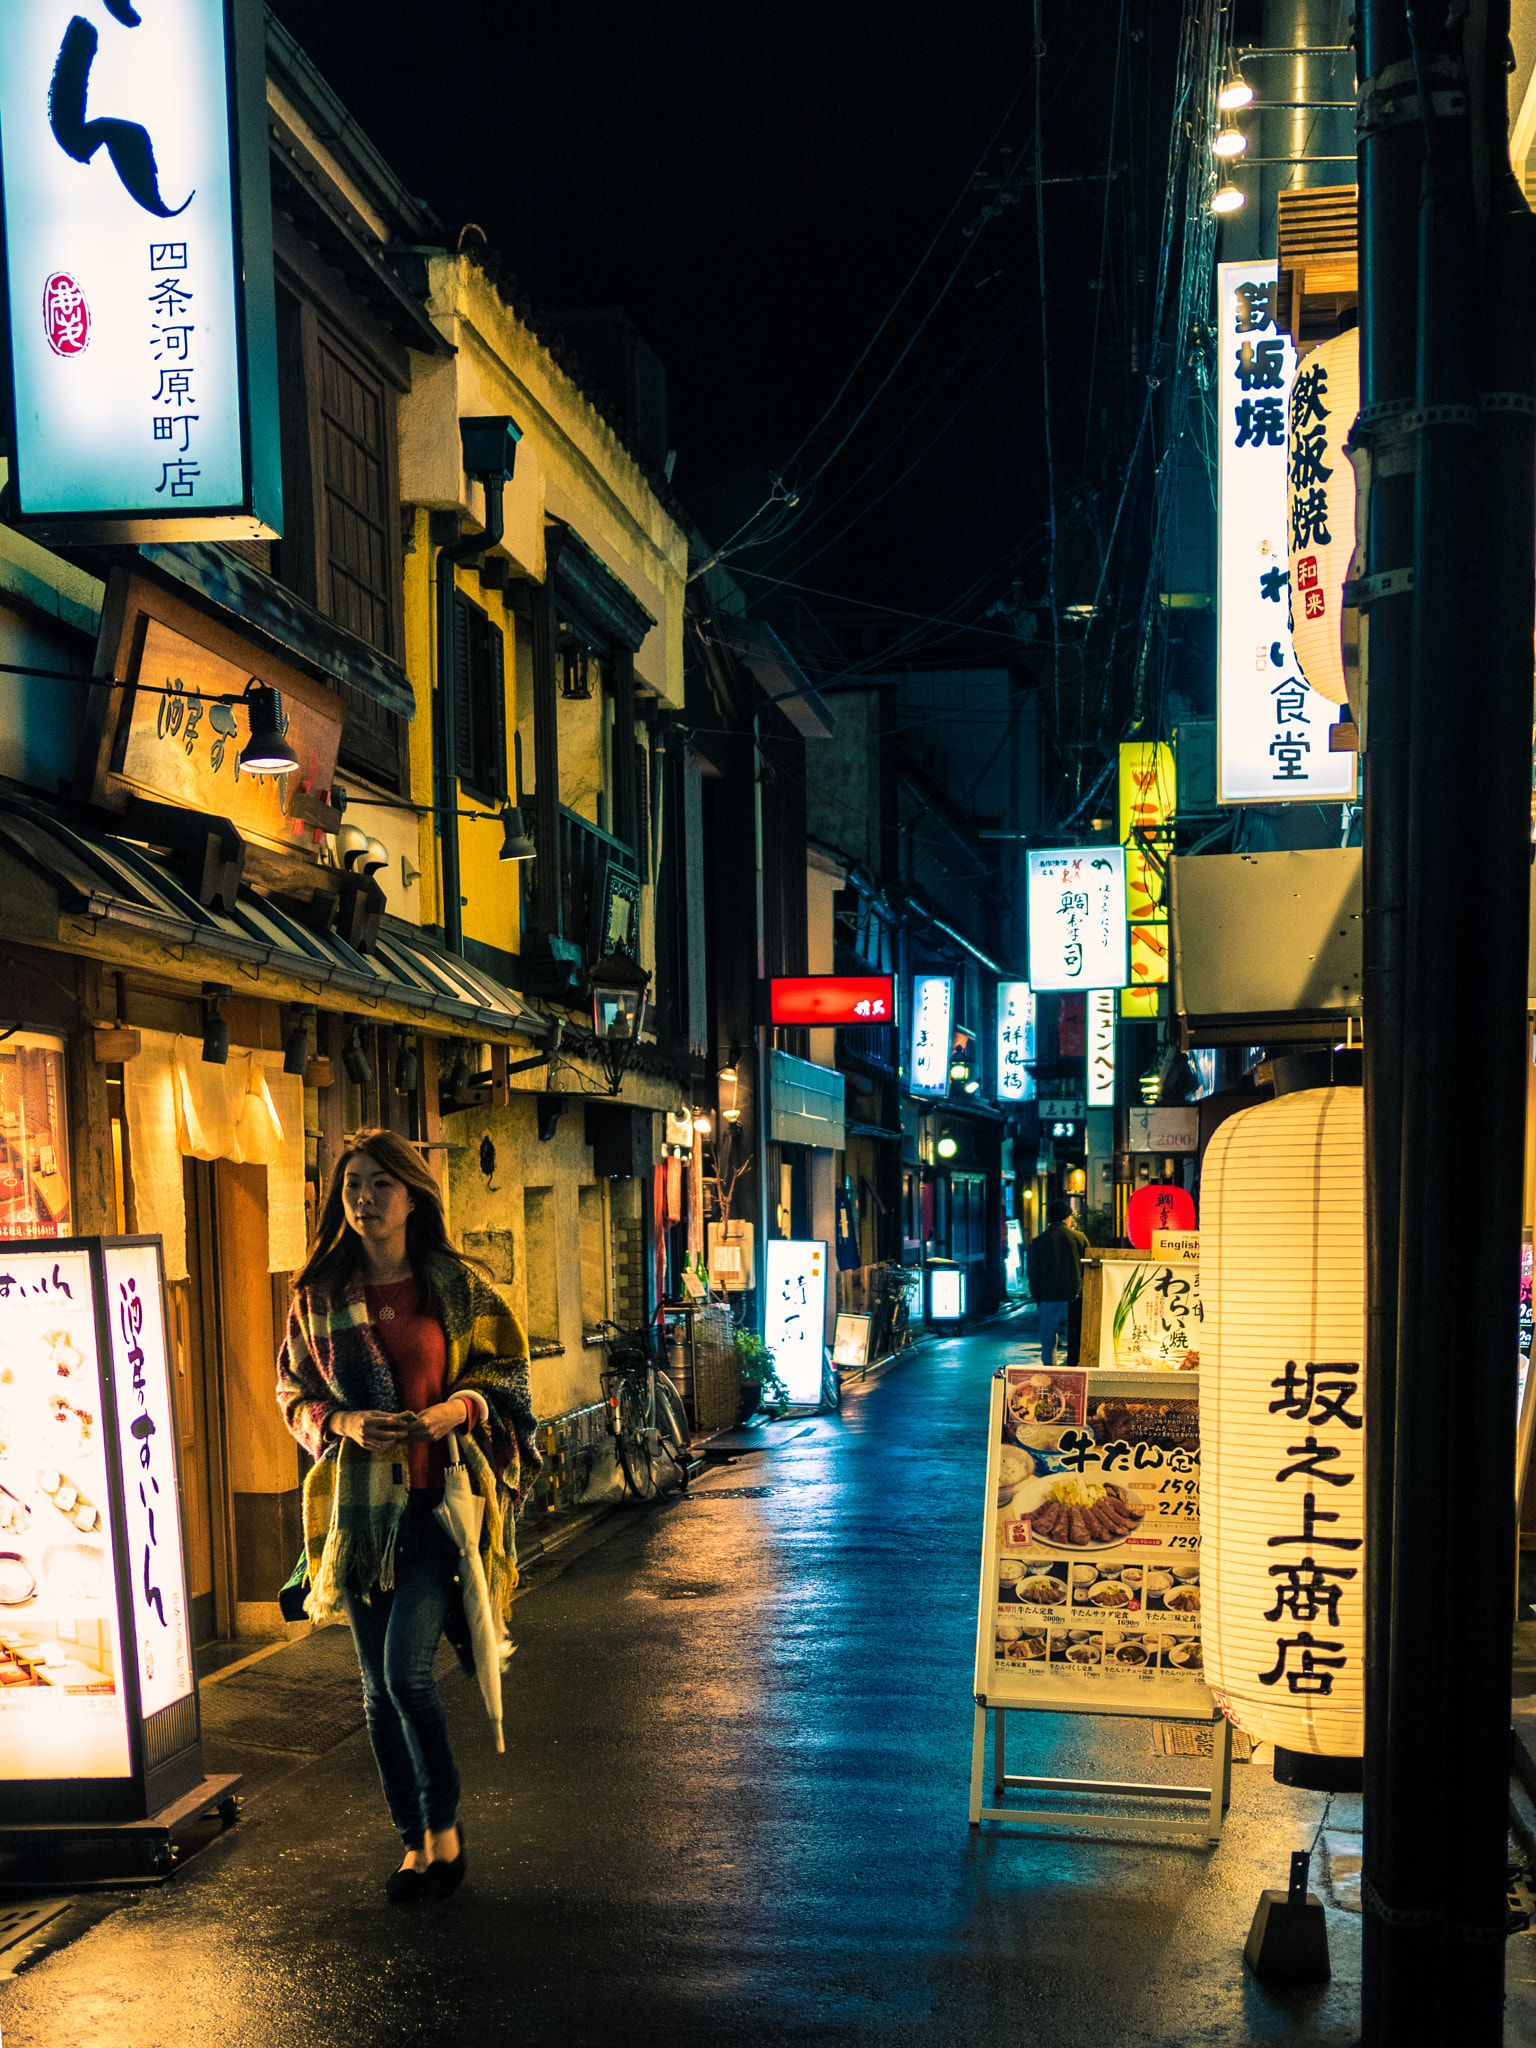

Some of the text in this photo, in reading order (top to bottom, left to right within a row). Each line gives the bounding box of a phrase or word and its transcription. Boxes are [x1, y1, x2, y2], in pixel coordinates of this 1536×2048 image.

[148, 242, 201, 498] 四条河原町店
[1234, 281, 1284, 447] 鉄板焼
[1290, 362, 1333, 553] 鉄板焼
[1297, 556, 1325, 620] 和来
[1269, 676, 1311, 780] 食堂
[1095, 994, 1114, 1091] ミュンヘン
[1154, 1193, 1174, 1230] 鯛寿
[1160, 1239, 1200, 1251] English
[1258, 1359, 1364, 1696] 坂之上商店
[1071, 1608, 1129, 1619] 牛たんサラダ定食
[1104, 1666, 1154, 1675] 牛たんシチュー定食
